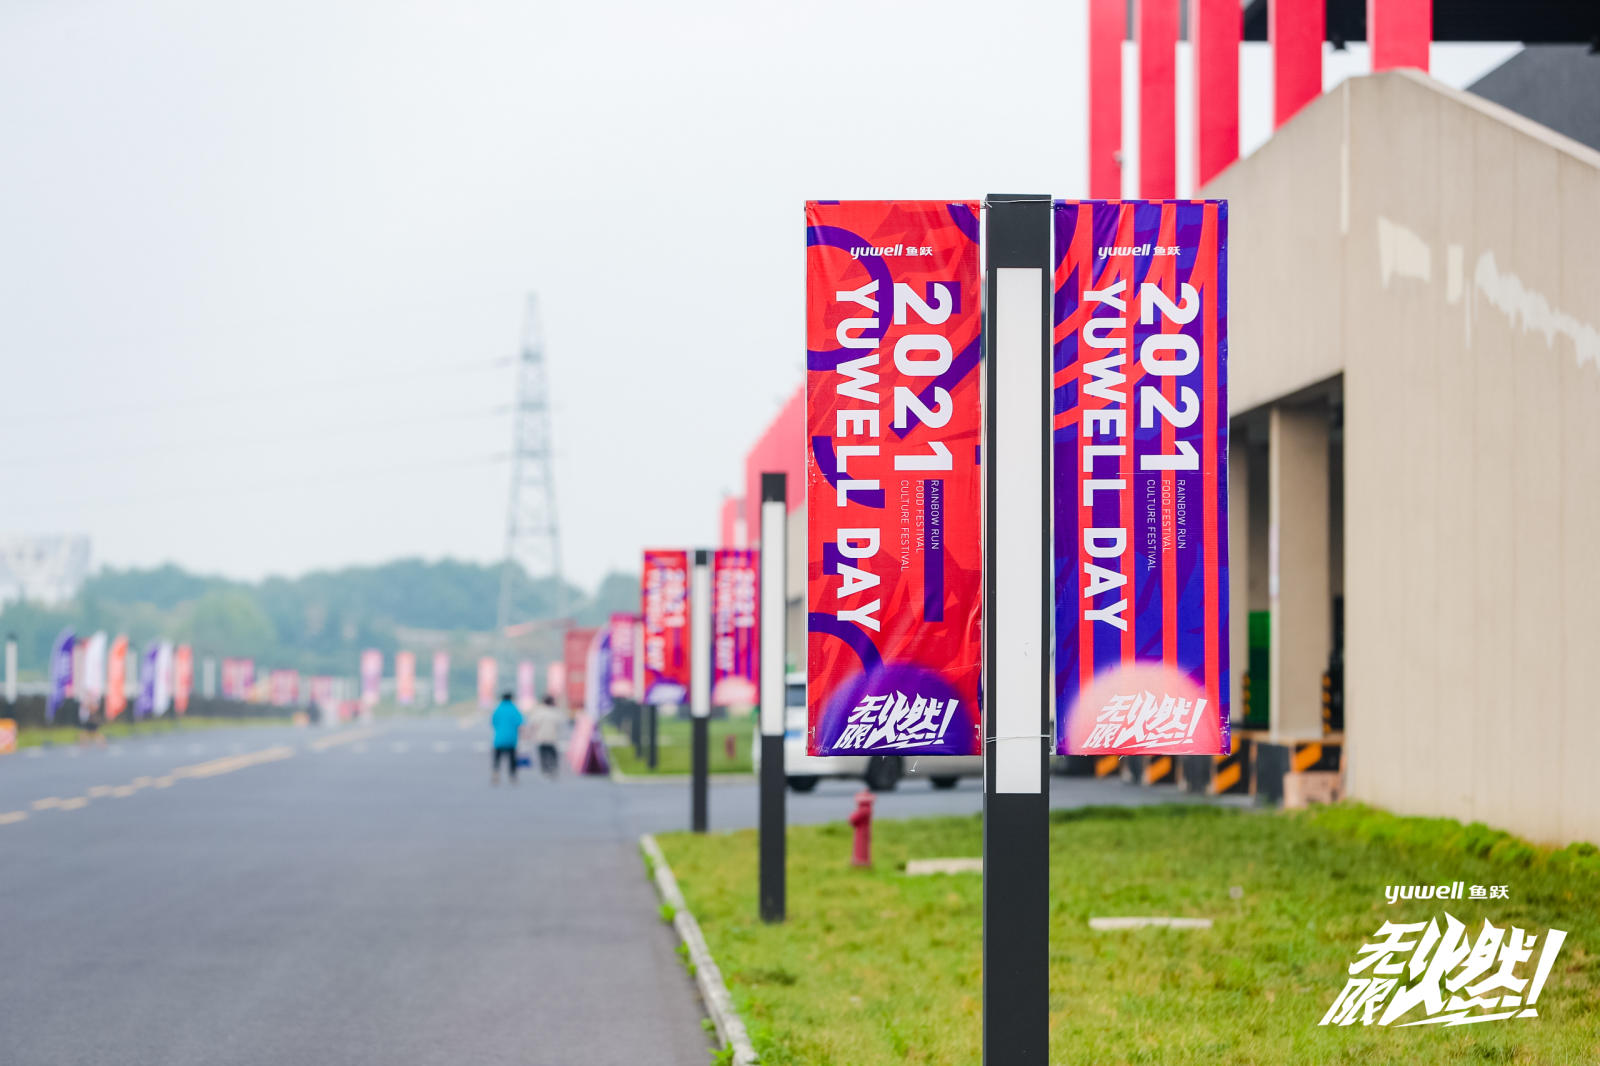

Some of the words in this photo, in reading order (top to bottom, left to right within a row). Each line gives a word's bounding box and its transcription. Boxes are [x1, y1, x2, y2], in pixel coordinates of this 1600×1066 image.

[850, 244, 903, 260] yuwell
[905, 246, 933, 257] 鱼跃
[1098, 243, 1151, 260] yuwell
[1153, 245, 1181, 256] 鱼跃
[835, 279, 880, 507] YUWELL
[893, 282, 953, 471] 2021
[1082, 279, 1127, 507] YUWELL
[1140, 282, 1200, 471] 2021
[900, 479, 910, 524] CULTURE
[915, 480, 925, 506] FOOD
[930, 479, 940, 526] RAINBOW
[1146, 479, 1156, 524] CULTURE
[1161, 479, 1171, 505] FOOD
[1177, 479, 1186, 526] RAINBOW
[900, 527, 910, 572] FESTIVAL
[915, 509, 925, 553] FESTIVAL
[930, 528, 940, 550] RUN
[1147, 526, 1157, 572] FESTIVAL
[1161, 508, 1172, 553] FESTIVAL
[1177, 528, 1187, 549] RUN
[836, 527, 881, 632] DAY
[1083, 527, 1128, 632] DAY
